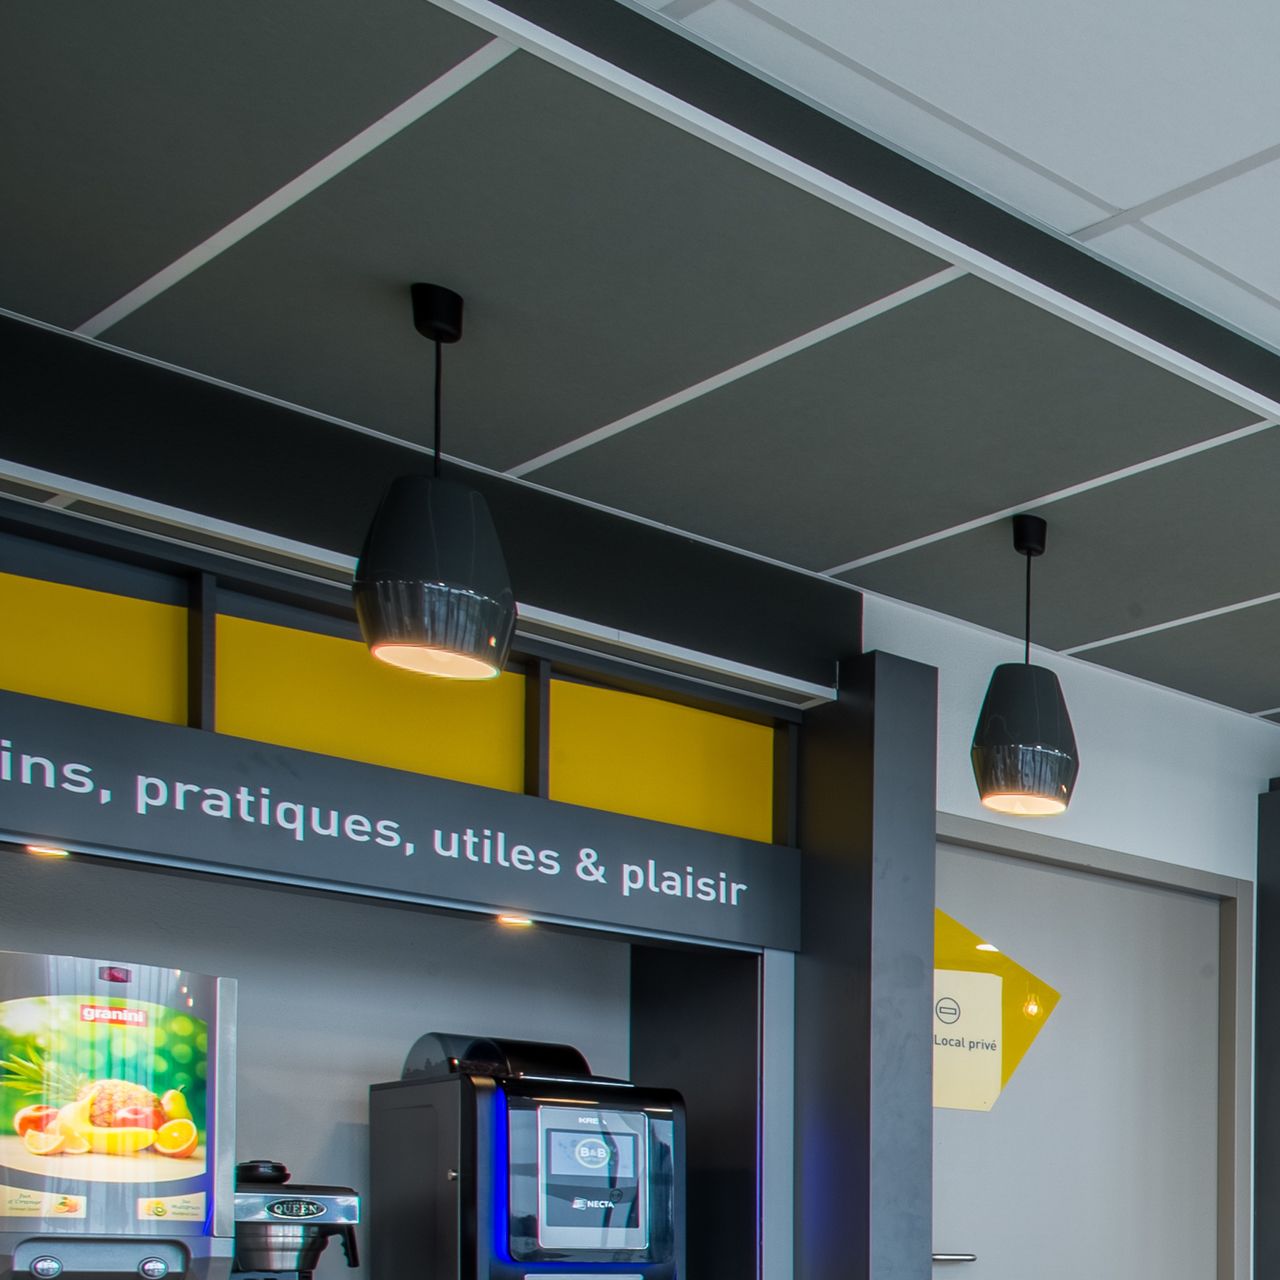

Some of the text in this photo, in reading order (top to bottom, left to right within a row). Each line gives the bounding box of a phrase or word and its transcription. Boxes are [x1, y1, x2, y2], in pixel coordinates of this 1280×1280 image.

[136, 774, 415, 857] pratiques,
[433, 828, 562, 875] utiles
[575, 848, 608, 884] &
[621, 859, 748, 906] plaisir
[82, 1007, 145, 1022] granini
[934, 1034, 997, 1051] Local privé
[273, 1204, 318, 1215] QUEEN
[587, 1200, 615, 1209] NECTA
